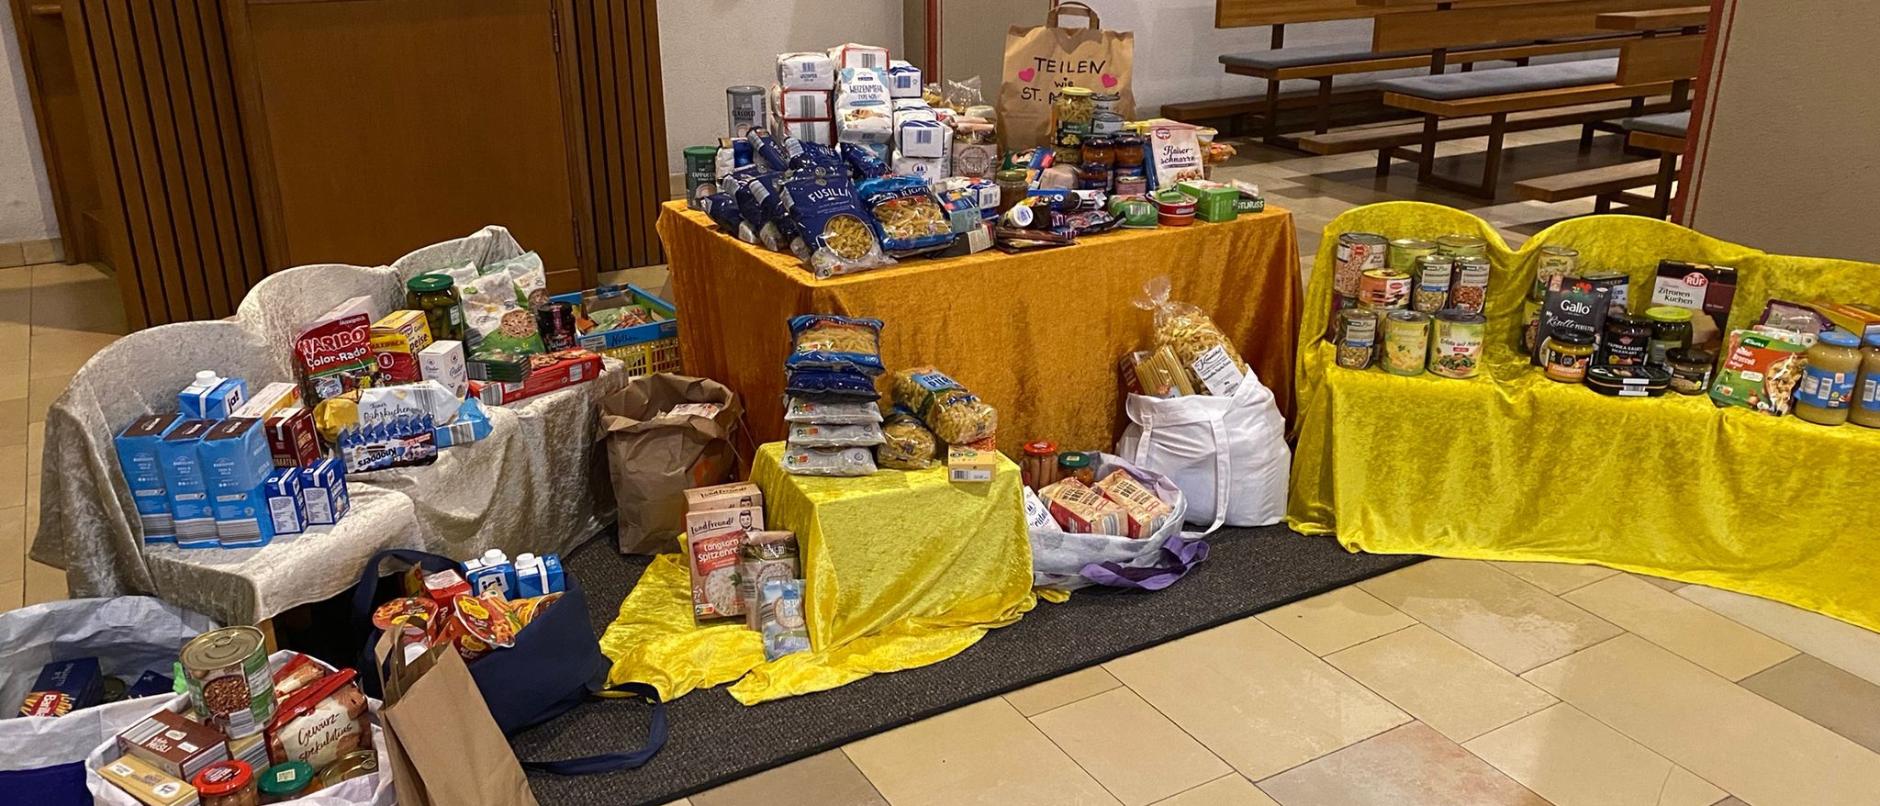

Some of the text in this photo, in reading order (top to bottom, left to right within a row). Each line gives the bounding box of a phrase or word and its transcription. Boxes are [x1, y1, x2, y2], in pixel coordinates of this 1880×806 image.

[1034, 57, 1106, 74] TEILEN
[1054, 77, 1074, 88] wie
[1021, 86, 1042, 102] ST.
[1686, 276, 1705, 286] RUF
[1658, 287, 1690, 298] Zitronen
[1664, 294, 1693, 305] Kuchen
[1560, 299, 1590, 315] Gallo
[297, 324, 368, 354] HARIBO
[357, 447, 397, 468] Knoppers
[704, 539, 739, 552] Langkorn
